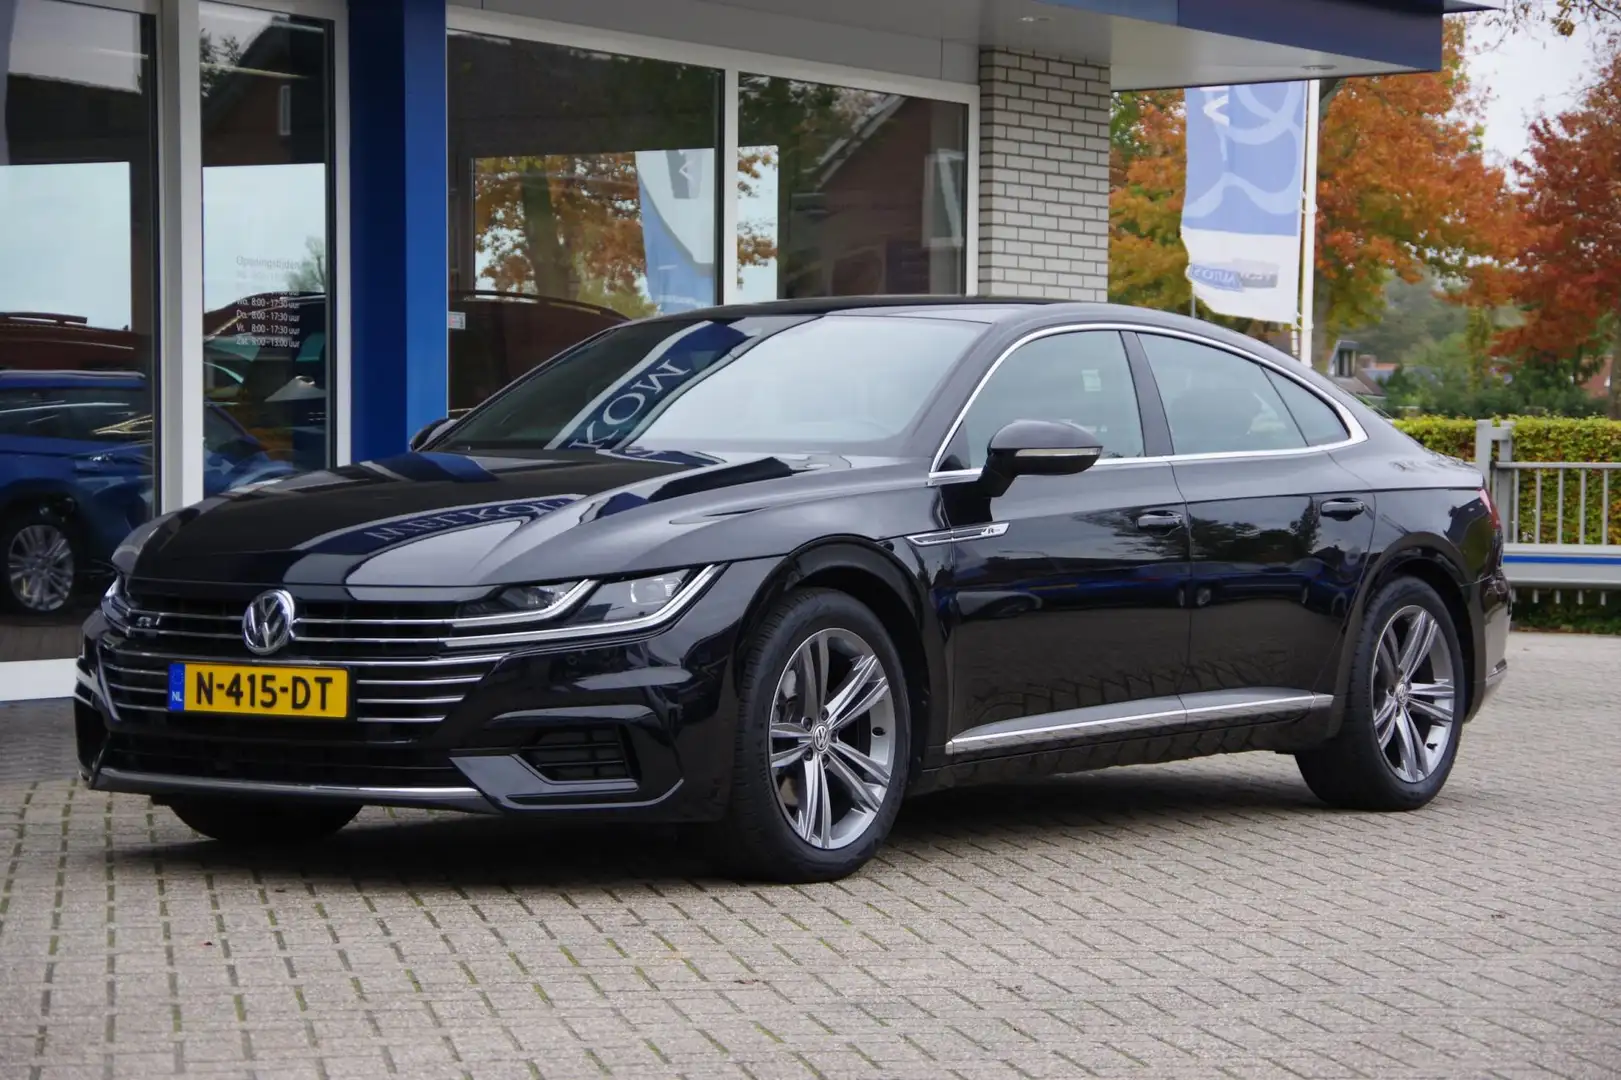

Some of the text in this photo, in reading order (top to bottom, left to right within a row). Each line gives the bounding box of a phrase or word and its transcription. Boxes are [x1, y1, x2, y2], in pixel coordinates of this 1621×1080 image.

[251, 297, 266, 307] 8:00
[270, 299, 288, 308] 17:30
[251, 311, 266, 320] 8:00
[270, 312, 288, 321] 17:30
[236, 323, 245, 332] Vr.
[251, 323, 266, 333] 8:00
[270, 325, 288, 334] 17:30
[289, 340, 300, 348] uur
[171, 671, 333, 711] NL N-415-DT
